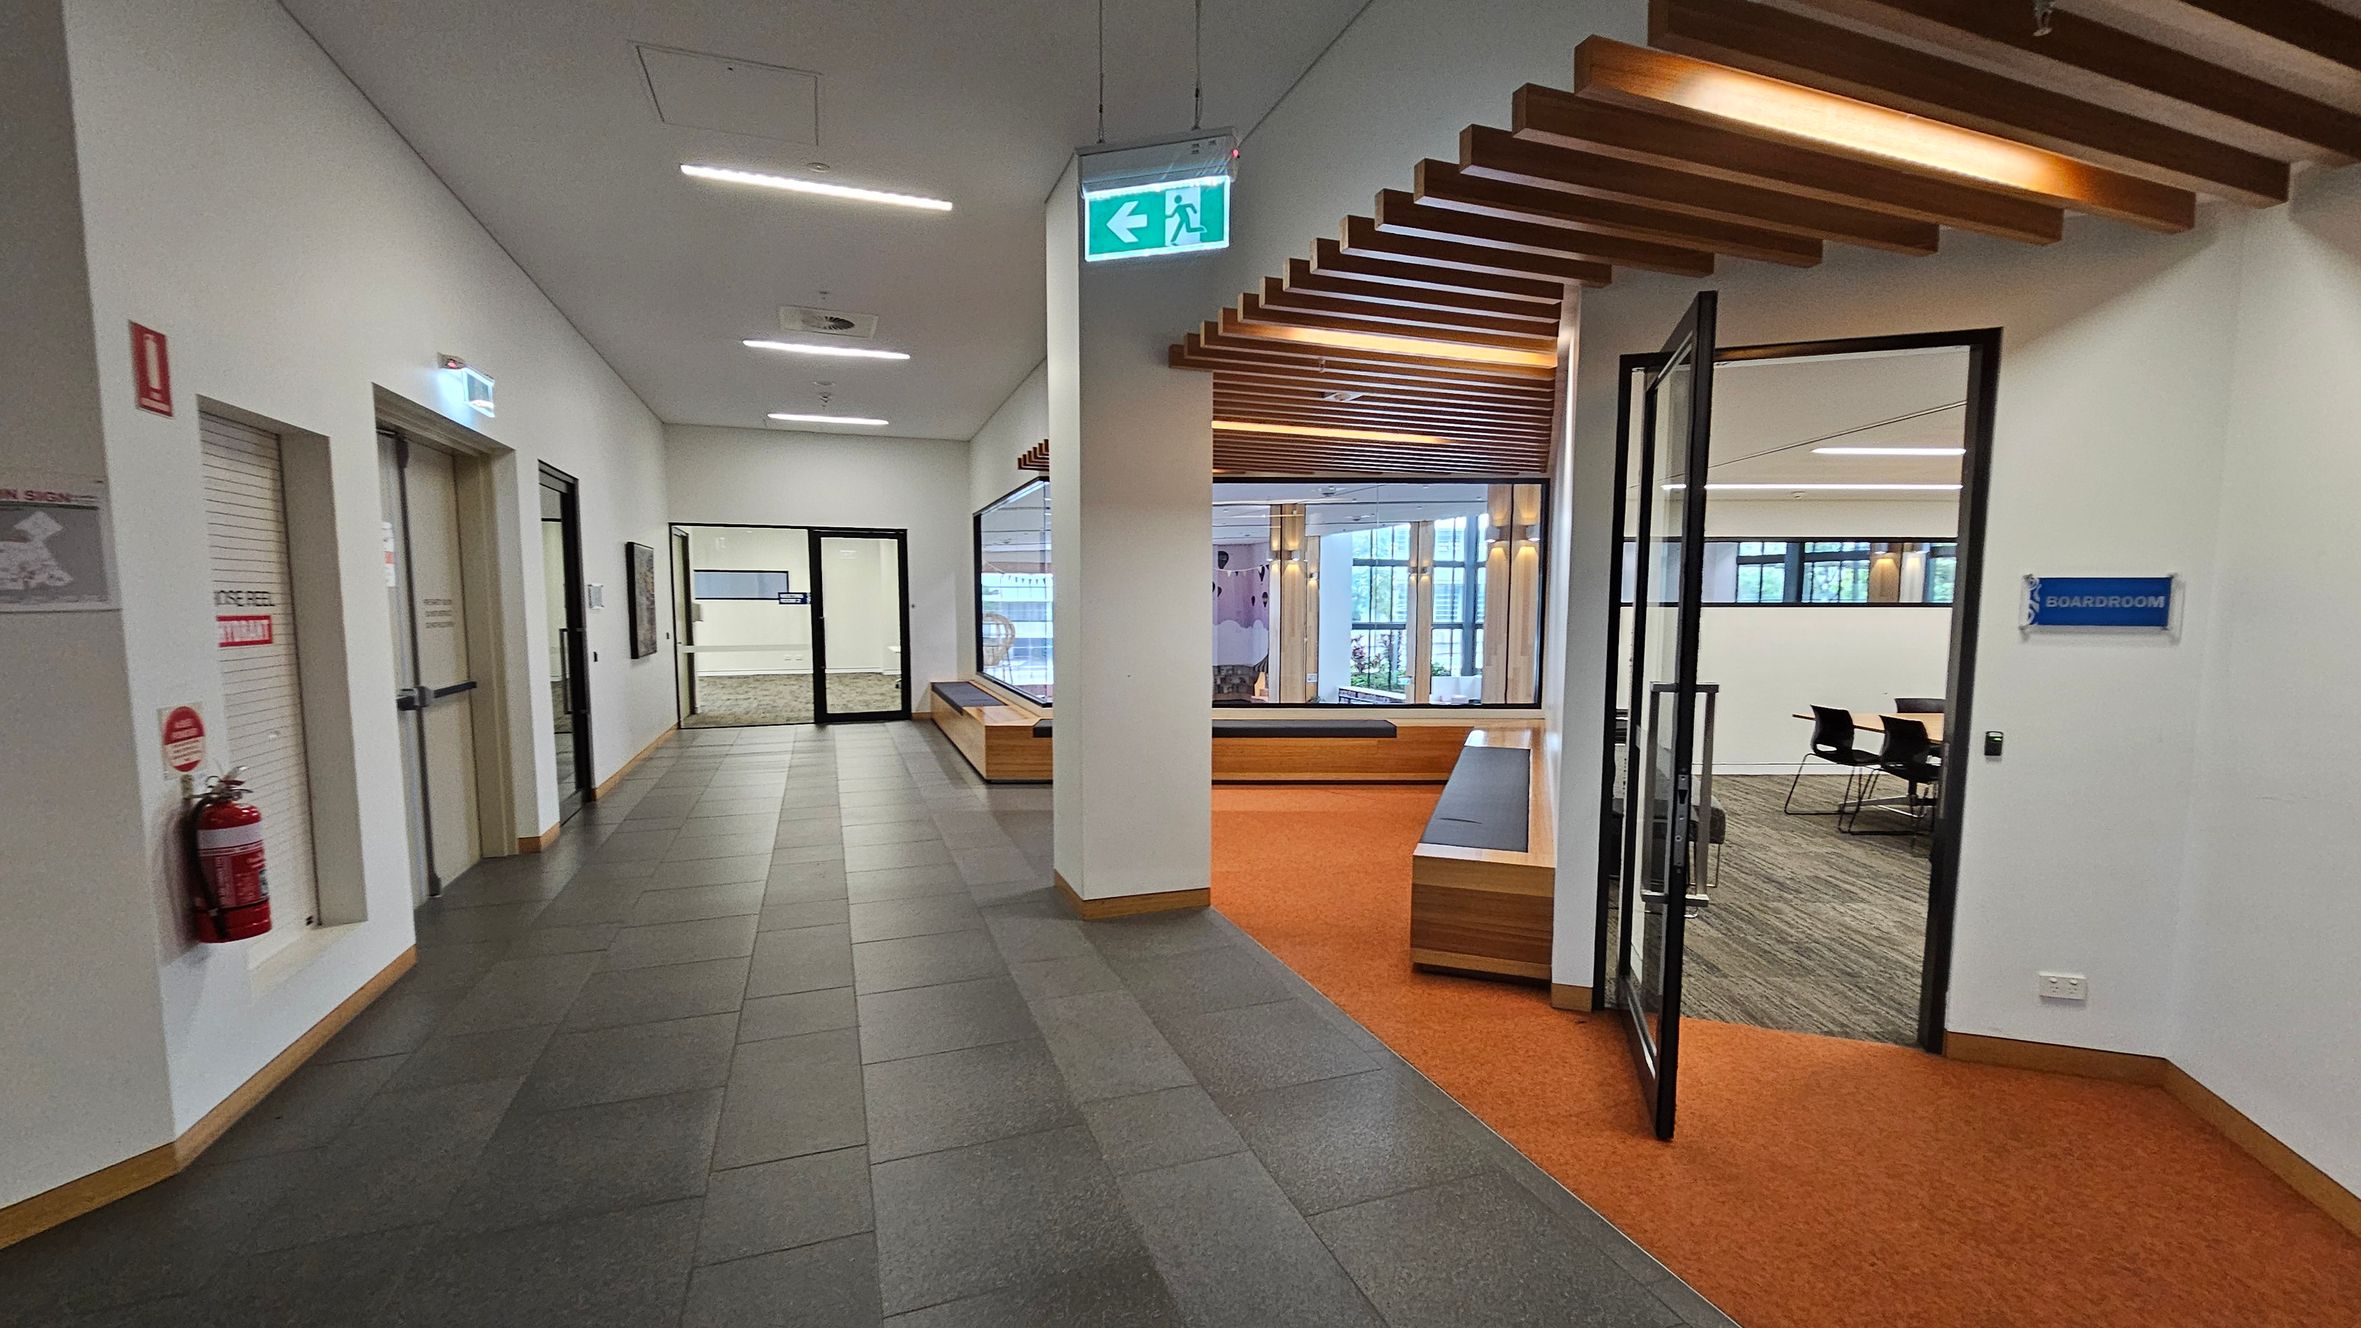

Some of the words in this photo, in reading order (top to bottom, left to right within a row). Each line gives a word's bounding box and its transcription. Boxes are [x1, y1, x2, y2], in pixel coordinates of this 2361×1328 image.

[24, 489, 71, 503] SIGN
[245, 590, 275, 607] REEL
[2045, 595, 2165, 608] BOARDROOM
